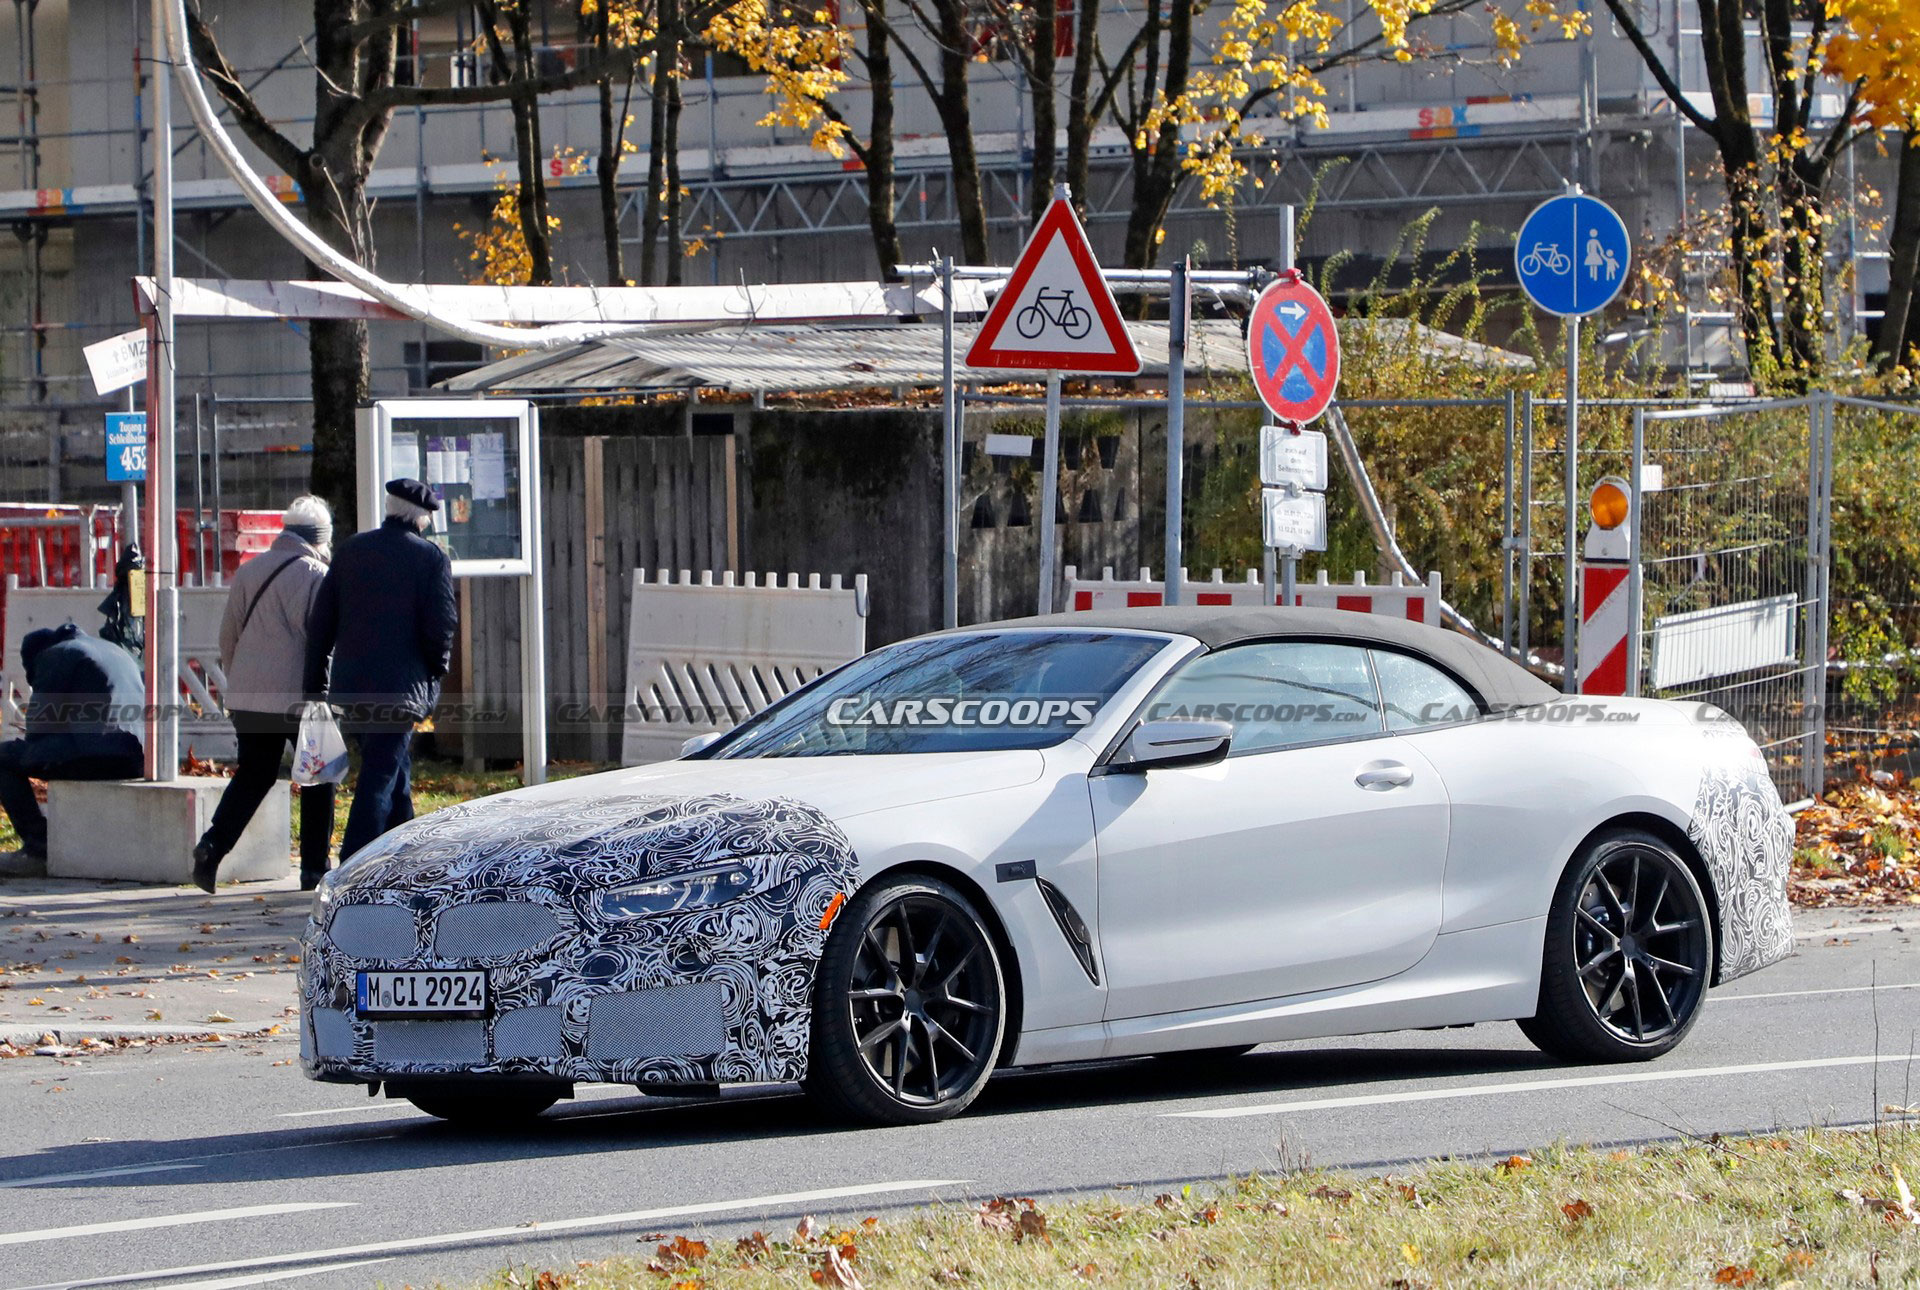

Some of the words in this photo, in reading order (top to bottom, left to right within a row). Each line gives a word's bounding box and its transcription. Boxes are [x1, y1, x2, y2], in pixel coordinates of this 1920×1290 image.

[368, 977, 380, 1007] M
[393, 977, 419, 1007] CI
[425, 976, 482, 1007] 2924
